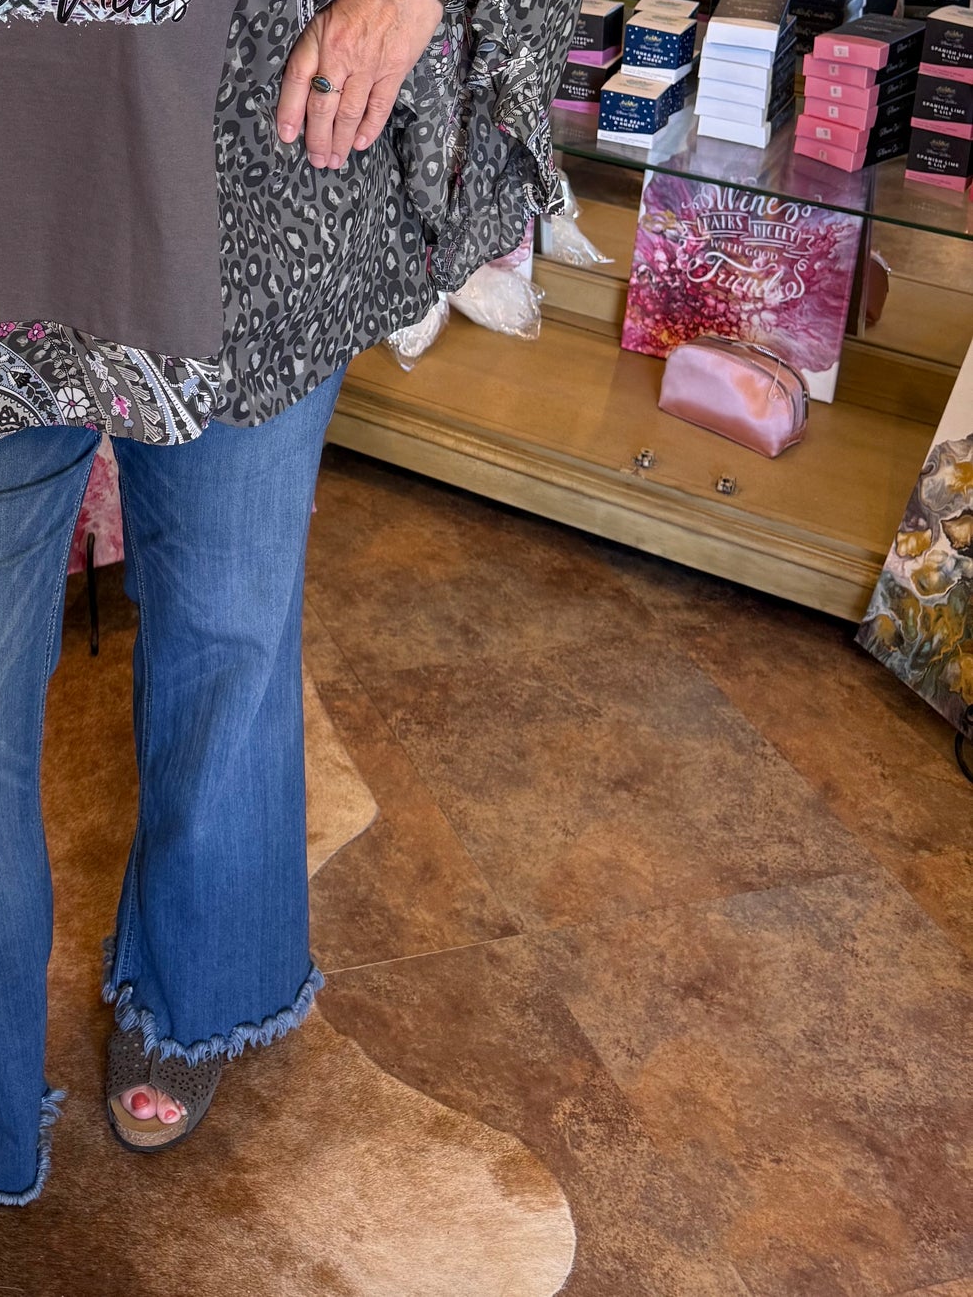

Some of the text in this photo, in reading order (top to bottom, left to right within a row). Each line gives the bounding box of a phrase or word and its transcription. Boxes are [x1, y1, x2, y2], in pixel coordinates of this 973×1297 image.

[702, 215, 797, 242] PAIRS NICELY
[710, 238, 778, 261] WITH GOOD
[687, 251, 809, 303] Friends
